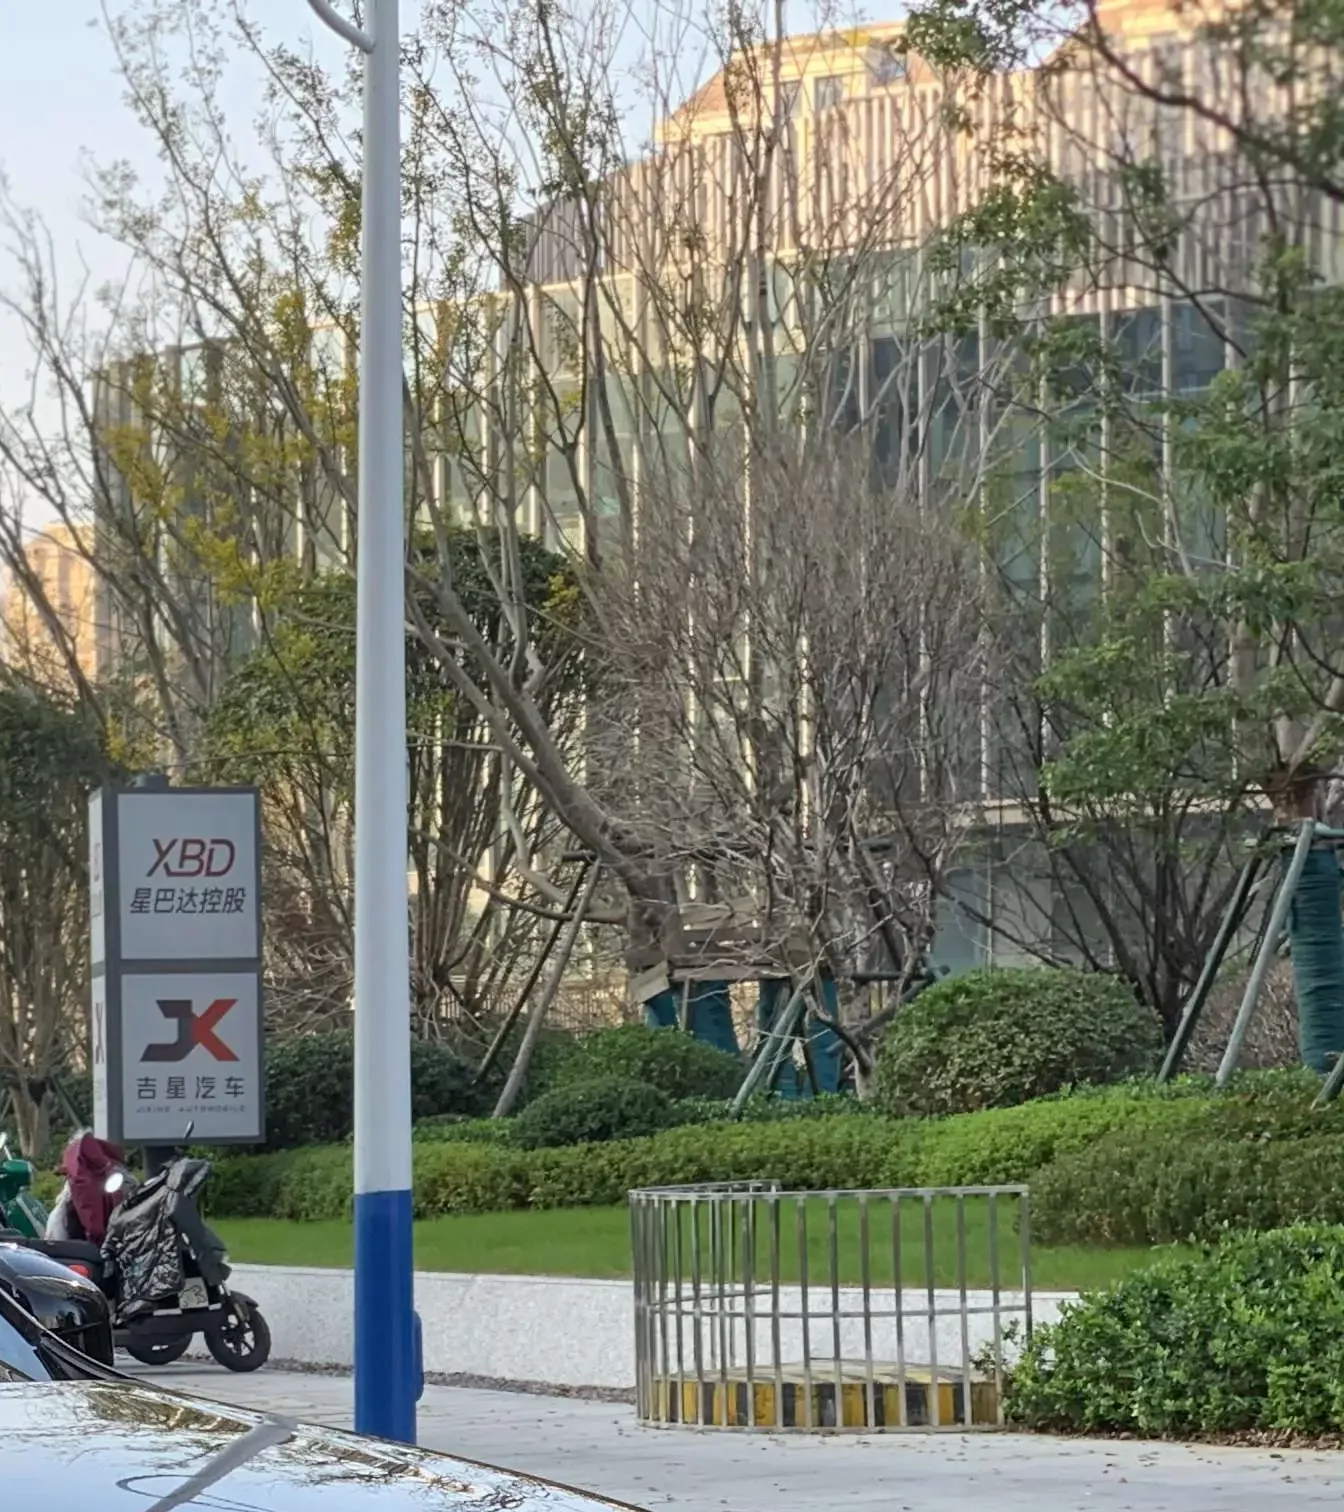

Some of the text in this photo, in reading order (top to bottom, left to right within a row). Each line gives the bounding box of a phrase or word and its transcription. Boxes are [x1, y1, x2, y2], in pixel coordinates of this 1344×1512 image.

[146, 838, 236, 878] XBD
[129, 886, 247, 915] 星巴达控股
[136, 1076, 246, 1100] 吉星汽车
